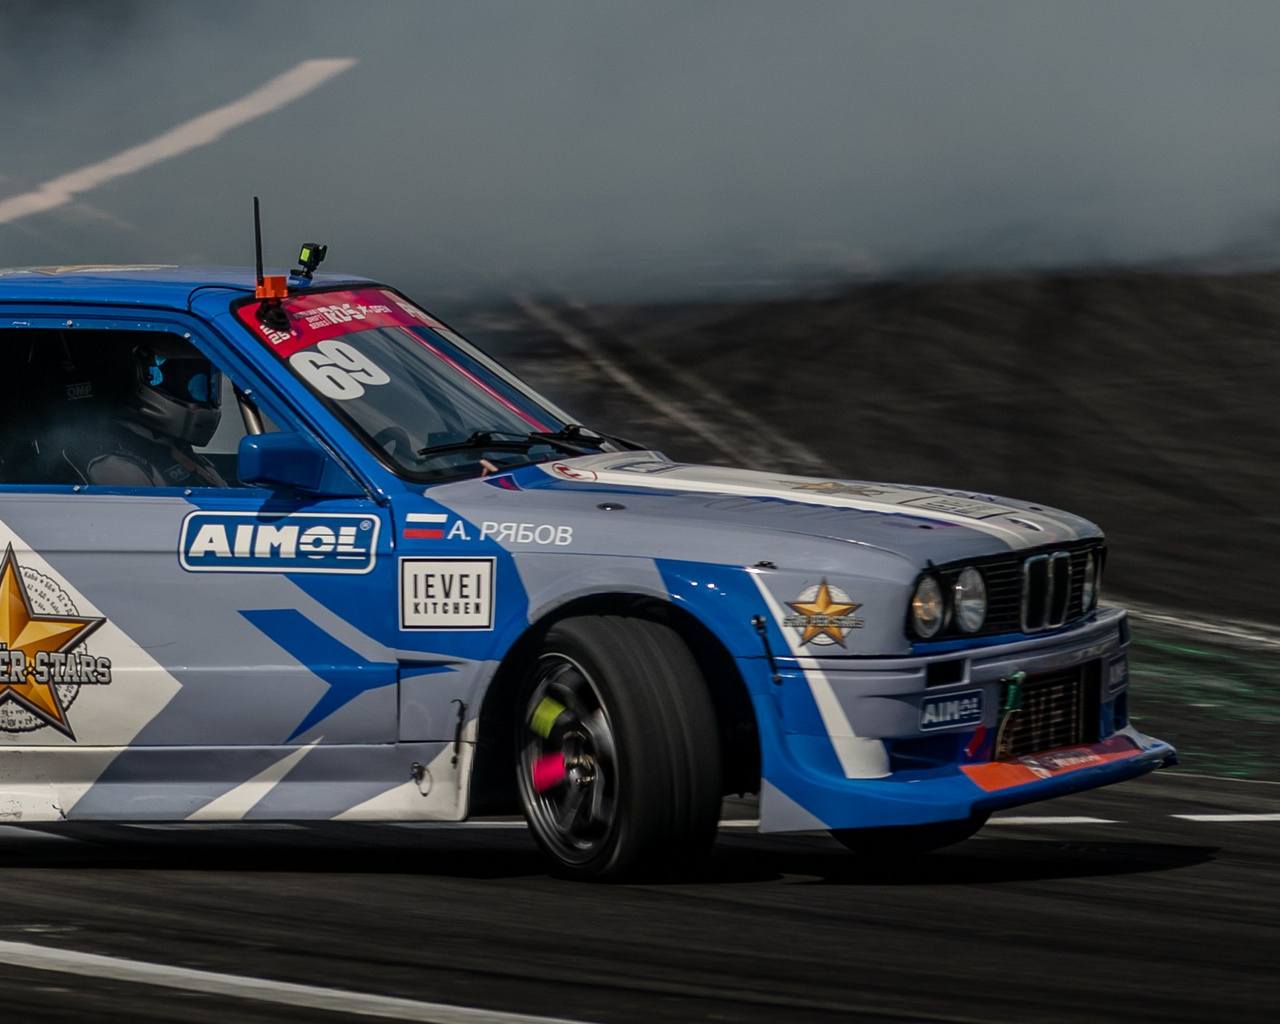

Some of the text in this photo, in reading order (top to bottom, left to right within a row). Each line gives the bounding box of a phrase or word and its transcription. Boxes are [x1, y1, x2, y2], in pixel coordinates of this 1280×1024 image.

[289, 340, 390, 400] 69
[447, 520, 573, 545] А. РЯБОВ
[413, 602, 481, 614] KITCHEN
[35, 651, 112, 685] STARS
[921, 698, 981, 724] AIMOL
